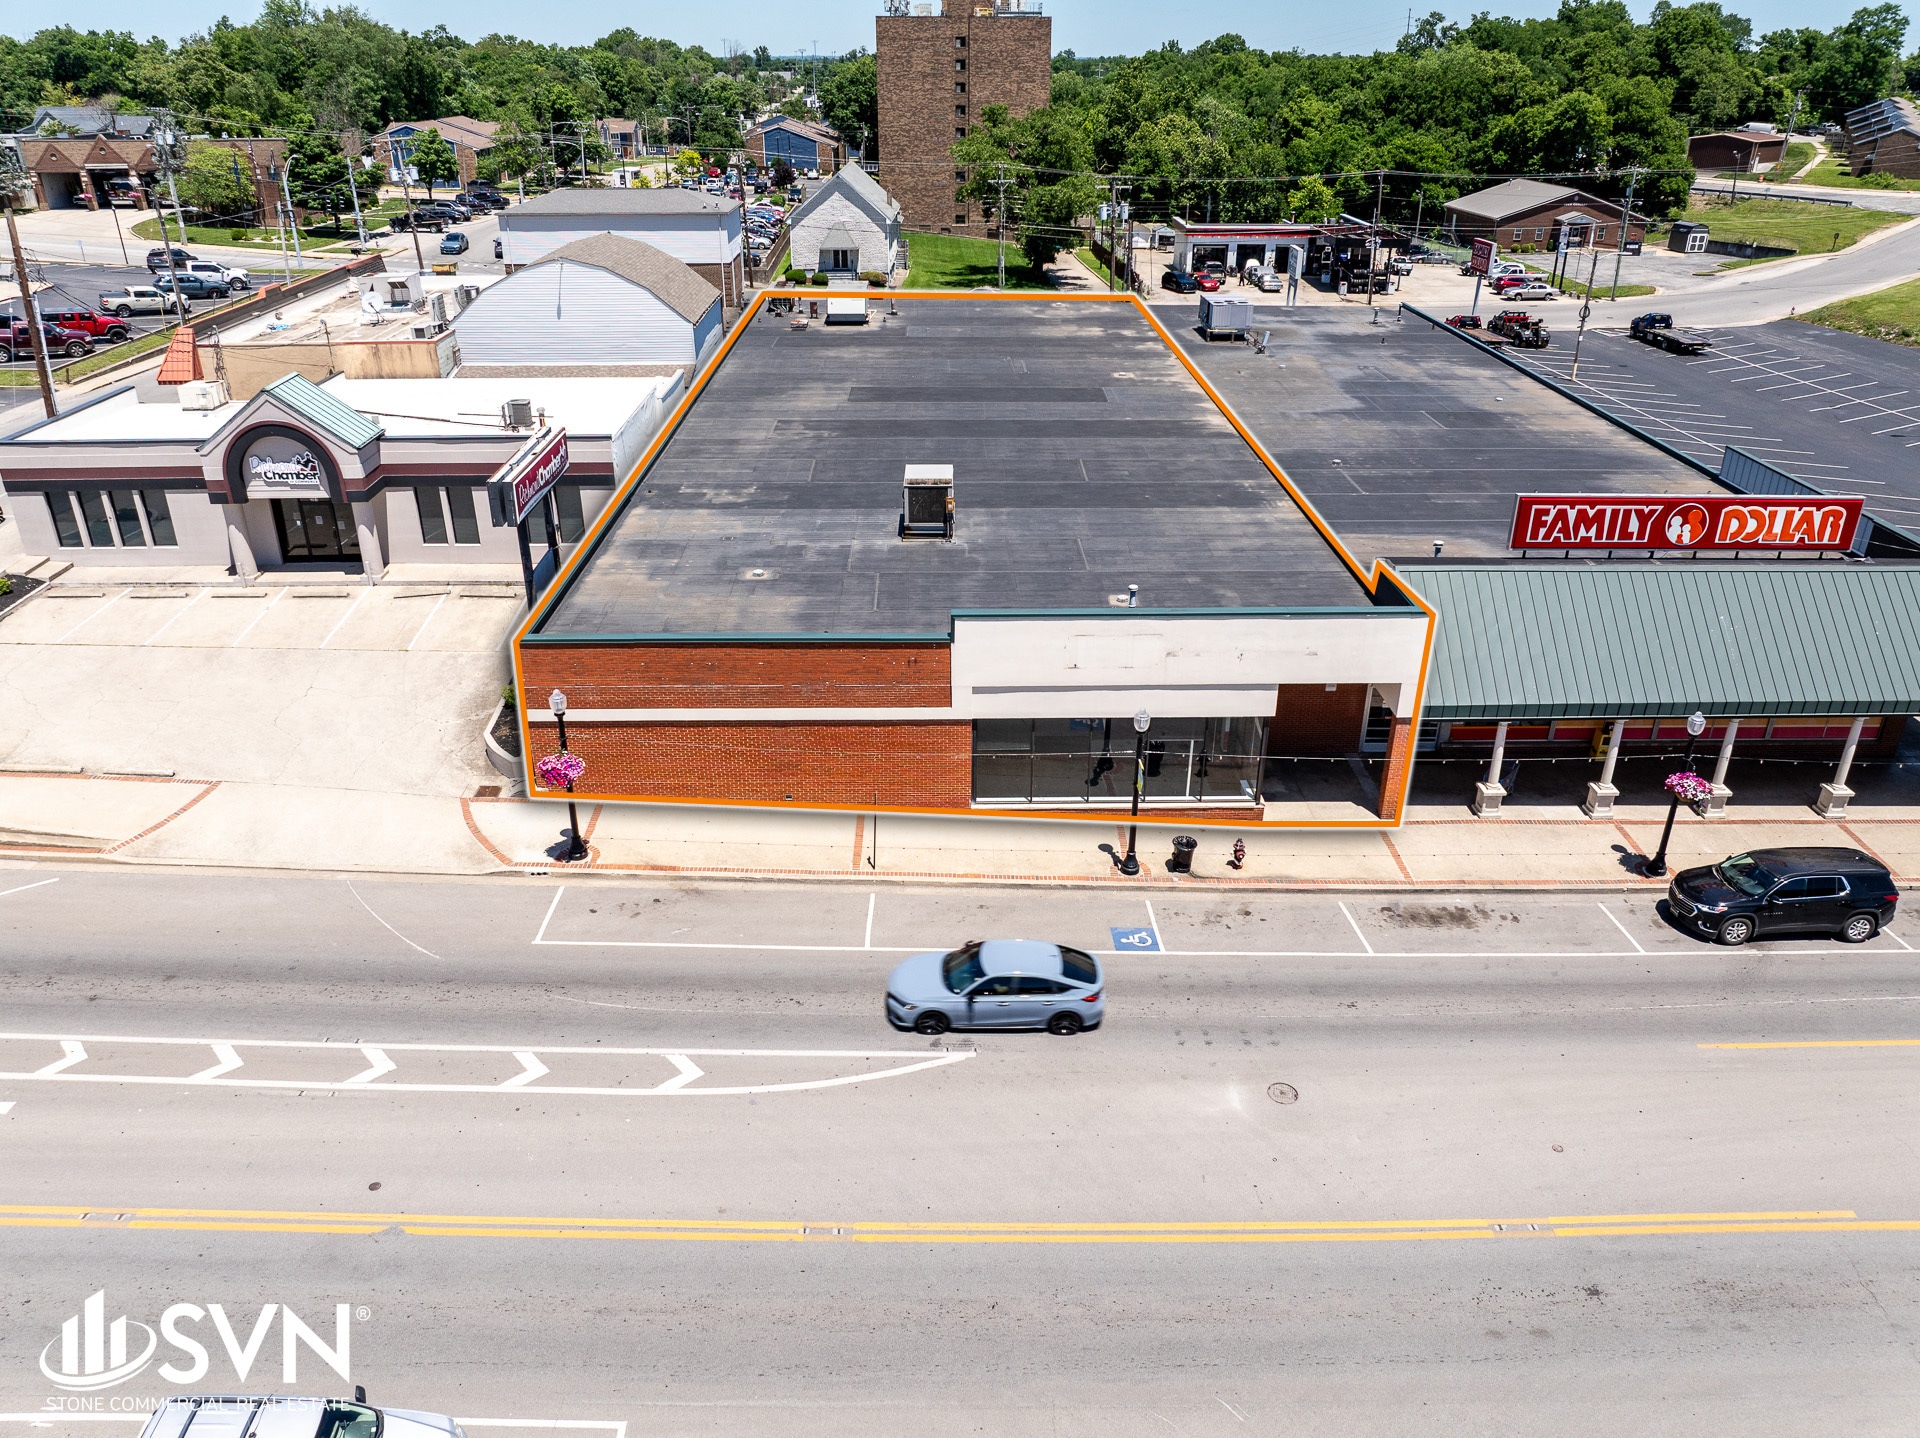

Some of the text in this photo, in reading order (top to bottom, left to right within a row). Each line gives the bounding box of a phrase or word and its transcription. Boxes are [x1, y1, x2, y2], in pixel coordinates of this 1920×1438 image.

[263, 470, 320, 480] Chamber
[539, 452, 562, 485] Chamber
[1526, 505, 1847, 544] FAMILY DOLLAR
